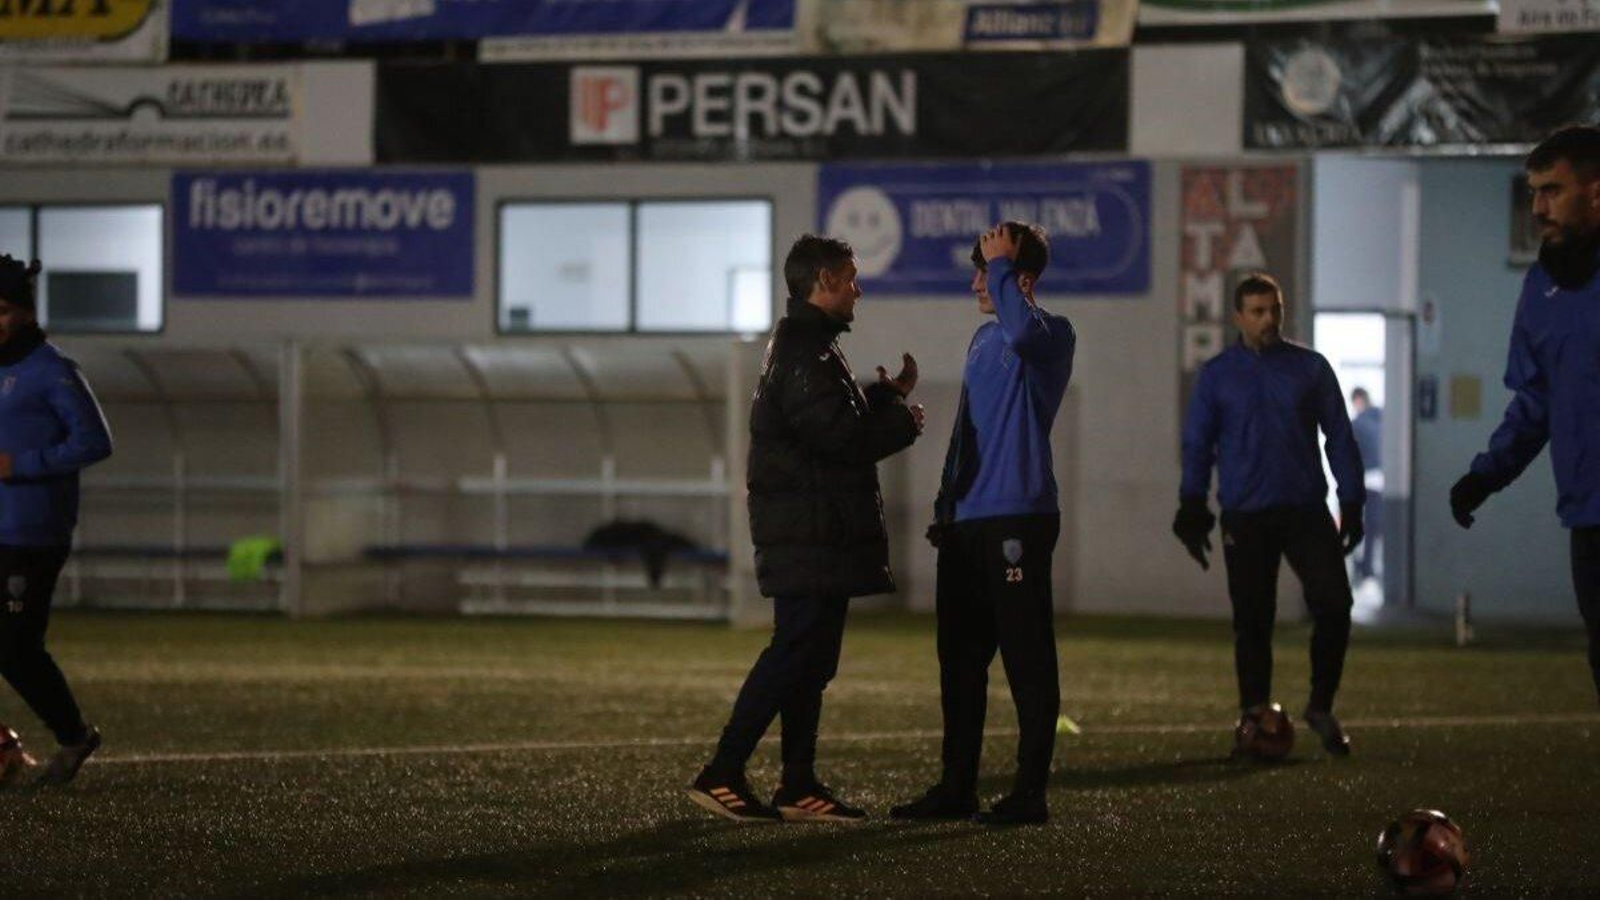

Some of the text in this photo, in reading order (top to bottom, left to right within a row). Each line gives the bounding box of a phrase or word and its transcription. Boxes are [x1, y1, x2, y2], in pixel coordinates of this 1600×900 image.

[974, 9, 1055, 35] Allianz
[649, 69, 918, 137] PERSAN
[188, 178, 457, 231] fisioremove
[1005, 567, 1024, 582] 23
